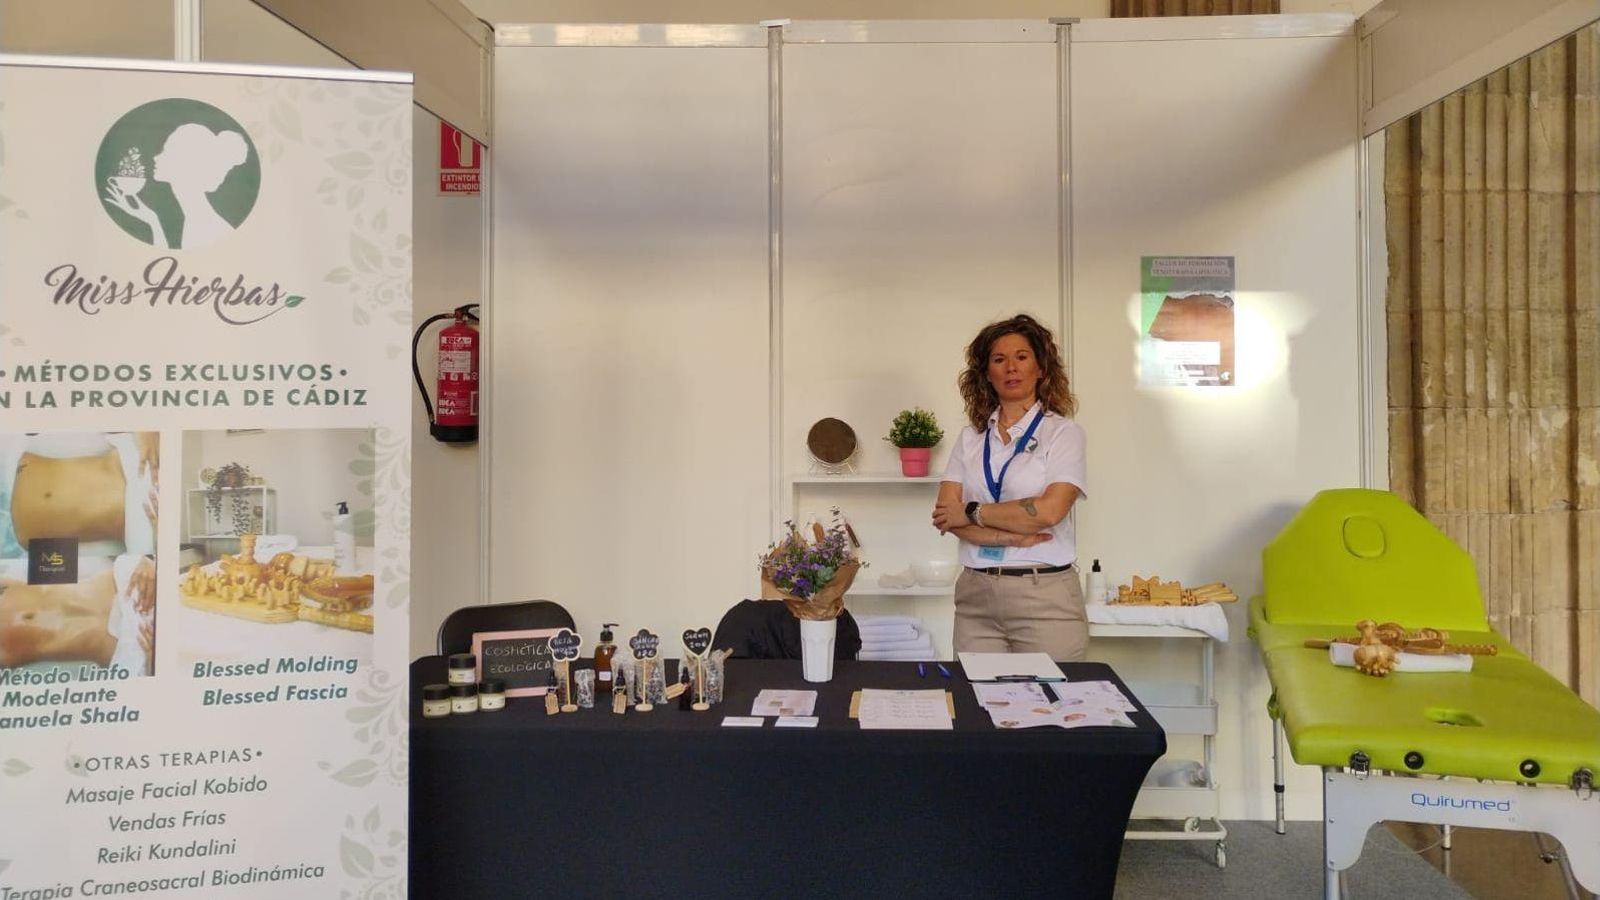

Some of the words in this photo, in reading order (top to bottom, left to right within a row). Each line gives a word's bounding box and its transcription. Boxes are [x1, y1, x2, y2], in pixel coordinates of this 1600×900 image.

[441, 174, 476, 182] EXTINTOR
[44, 264, 141, 315] Miss
[143, 256, 286, 325] Hierbas
[14, 360, 152, 383] MÉTODOS
[165, 363, 333, 382] EXCLUSIVOS
[0, 391, 11, 409] N
[25, 391, 58, 409] LA
[71, 389, 231, 408] PROVINCIA
[243, 389, 275, 407] DE
[286, 384, 367, 407] CÁDIZ
[79, 664, 130, 683] Linfo
[193, 659, 270, 679] Blessed
[275, 655, 359, 675] Molding
[2, 686, 118, 708] Modelante
[202, 687, 280, 706] Blessed
[285, 684, 349, 702] Fascia
[0, 709, 73, 730] anuela
[80, 705, 140, 725] Shala
[85, 754, 151, 772] OTRAS
[160, 748, 252, 768] TERAPIAS
[66, 787, 135, 805] Masaje
[141, 780, 198, 800] Facial
[203, 775, 268, 796] Kobido
[1410, 793, 1510, 812] Quirumed
[108, 813, 176, 832] Vendas
[182, 810, 226, 828] Frías
[97, 845, 142, 865] Reiki
[148, 839, 237, 861] Kundalini
[0, 883, 74, 900] Terapia
[80, 871, 205, 897] Craneosacral
[211, 864, 326, 887] Biodinámica
